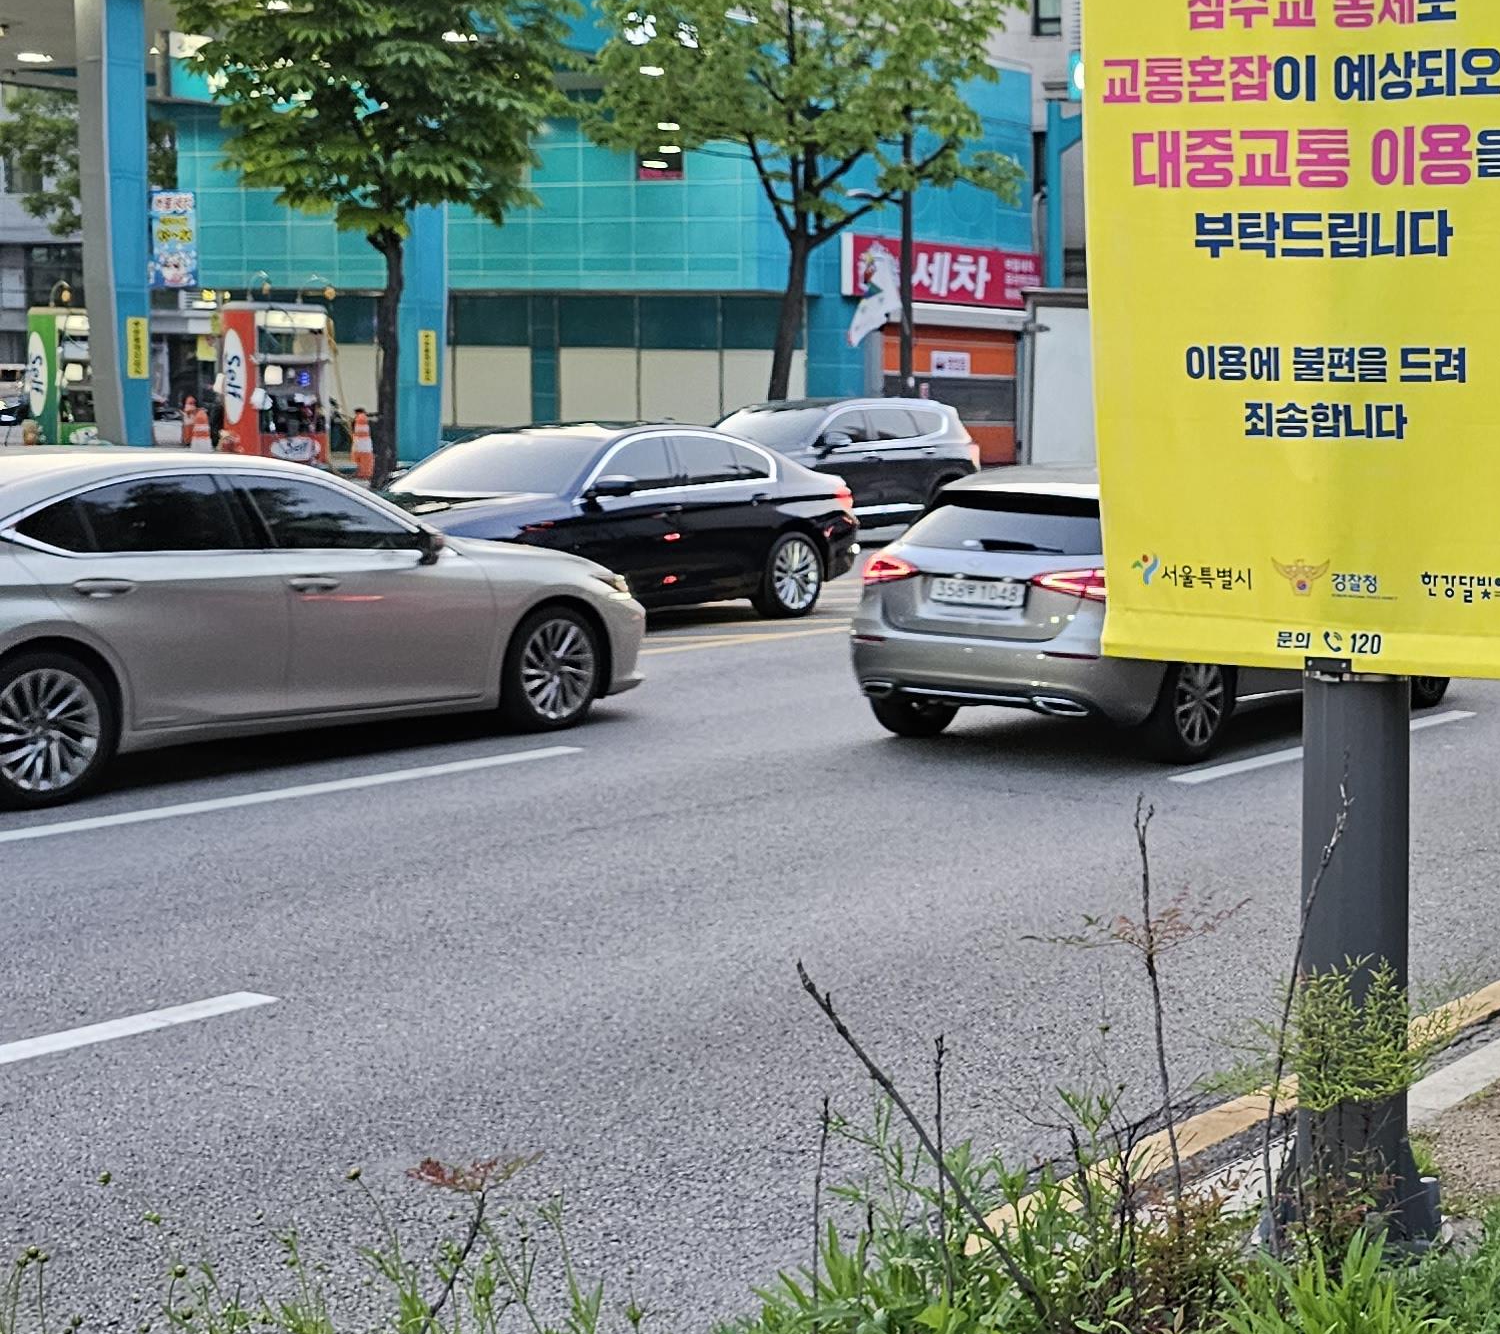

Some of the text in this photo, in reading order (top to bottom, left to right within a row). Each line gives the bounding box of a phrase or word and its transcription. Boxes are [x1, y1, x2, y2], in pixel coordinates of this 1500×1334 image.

[1104, 55, 1315, 103] 교통혼잡이
[1133, 129, 1350, 188] 대중교통
[1195, 210, 1453, 258] 부탁드립니다
[912, 251, 992, 300] 세차
[226, 354, 243, 399] Self
[1186, 346, 1466, 383] 이용에 불편을 드려
[1245, 403, 1407, 439] 죄송합니다
[1160, 563, 1254, 591] 서울특별시
[1331, 573, 1378, 594] 경찰청
[1276, 630, 1383, 655] 문의 120
